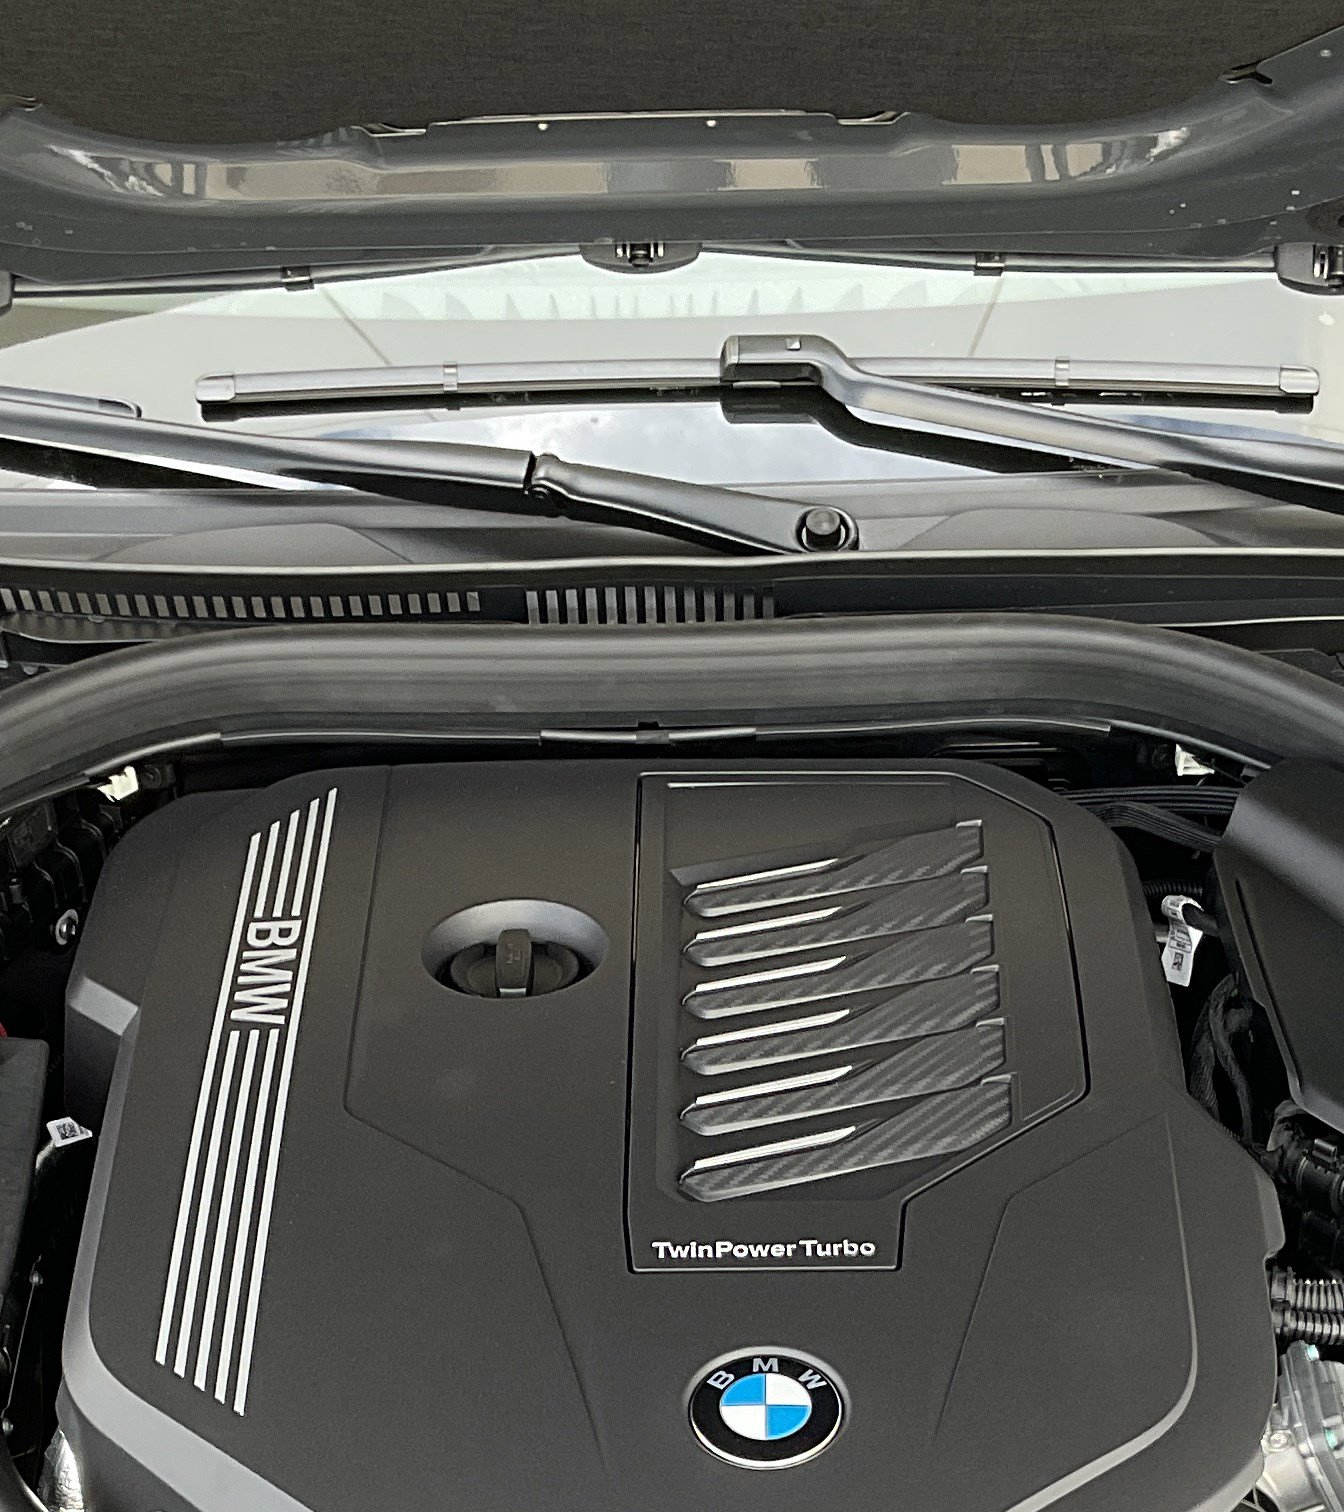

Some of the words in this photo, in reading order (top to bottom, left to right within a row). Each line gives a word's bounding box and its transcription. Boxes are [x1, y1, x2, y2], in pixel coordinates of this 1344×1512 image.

[230, 919, 303, 1025] BMW
[651, 1240, 797, 1259] TwinPower
[798, 1239, 876, 1257] Turbo
[706, 1357, 828, 1390] BMW
